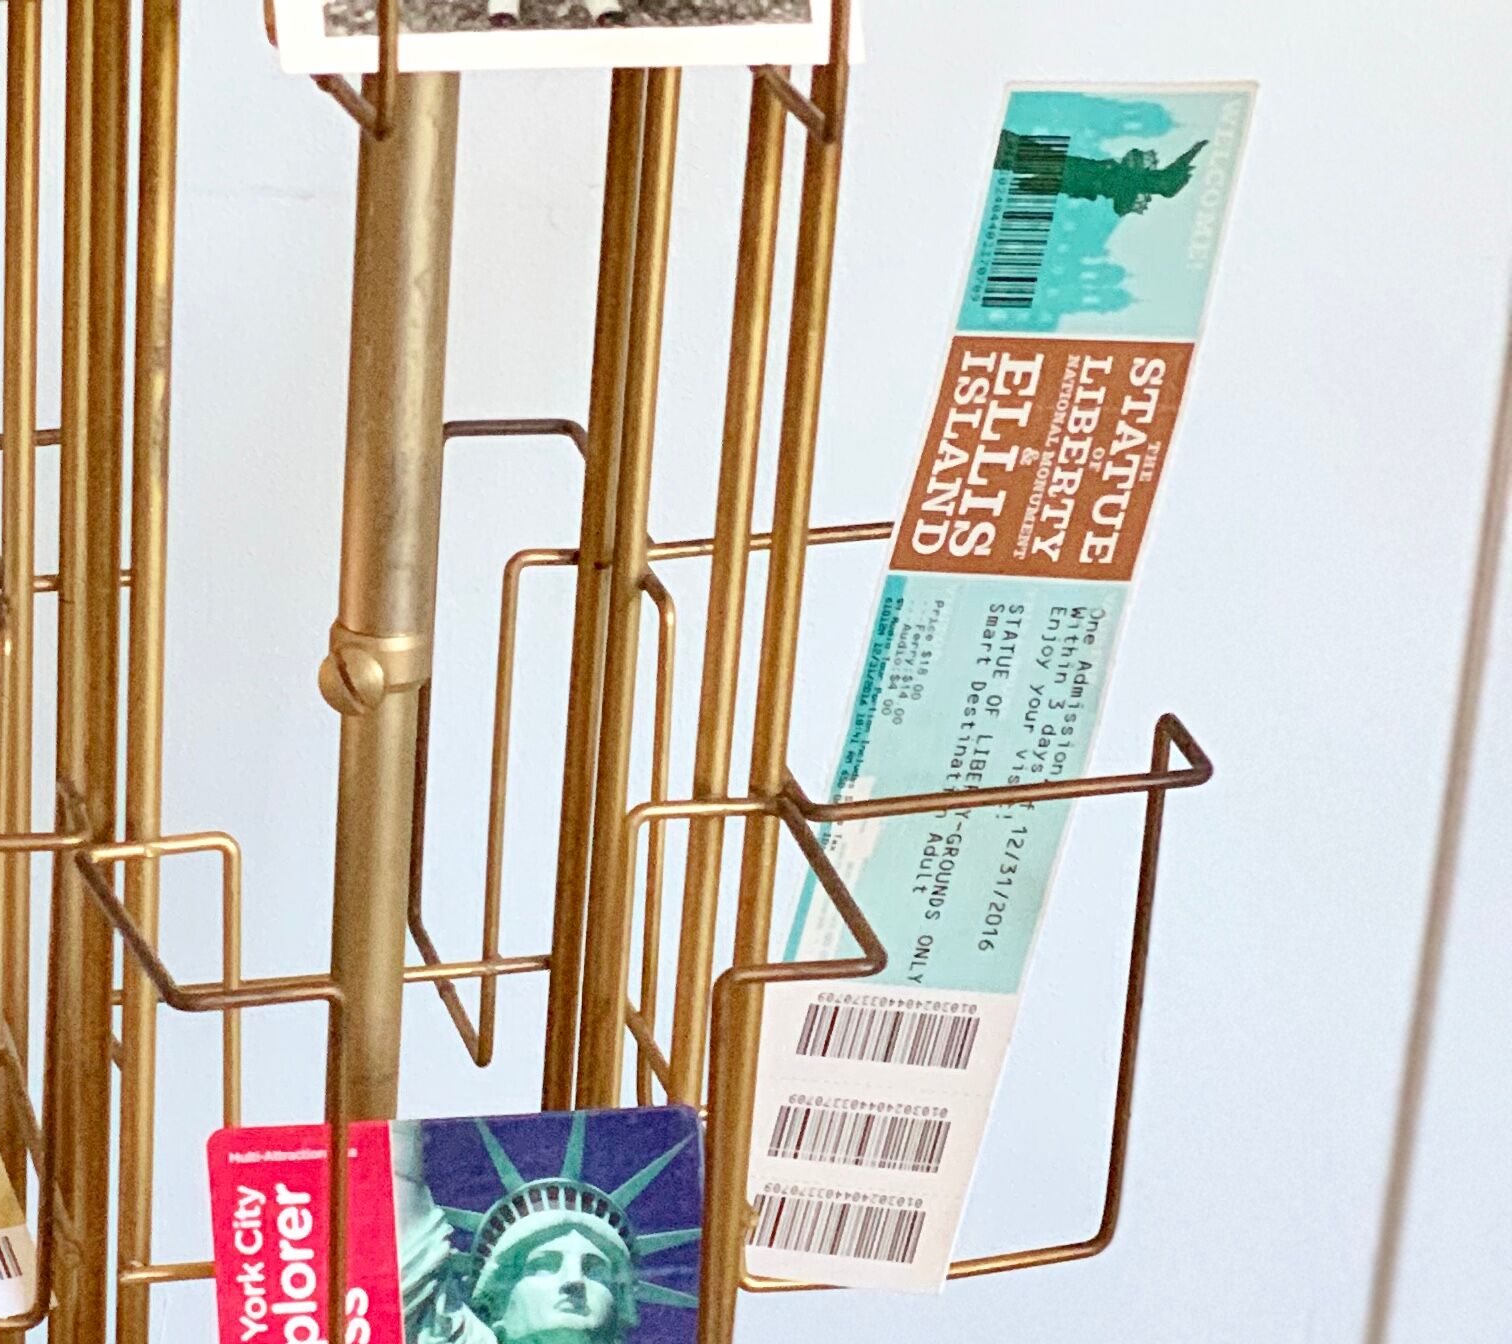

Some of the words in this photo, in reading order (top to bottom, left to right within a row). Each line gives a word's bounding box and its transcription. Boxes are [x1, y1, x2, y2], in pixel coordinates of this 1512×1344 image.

[1044, 353, 1080, 453] NATIONAL
[911, 349, 997, 555] ISLAND
[947, 351, 1046, 558] ELLIS
[1018, 446, 1040, 466] &
[1031, 354, 1114, 563] LIBERTY
[1079, 356, 1167, 565] STATUE
[1087, 445, 1106, 472] OF
[1137, 440, 1162, 482] THE
[1012, 449, 1056, 560] MONUMENT
[975, 603, 1006, 666] Smart
[991, 603, 1025, 679] STATUE
[1035, 606, 1068, 671] Enjoy
[1055, 605, 1088, 684] Within
[1081, 608, 1106, 645] One
[983, 693, 1003, 717] OF
[1022, 683, 1045, 734] your
[1046, 698, 1066, 710] 3
[1029, 723, 1057, 773] days
[911, 831, 944, 894] Adult
[976, 825, 1028, 952] 12/31/2016
[906, 934, 934, 984] ONLY
[231, 1184, 267, 1255] City
[235, 1261, 269, 1342] York
